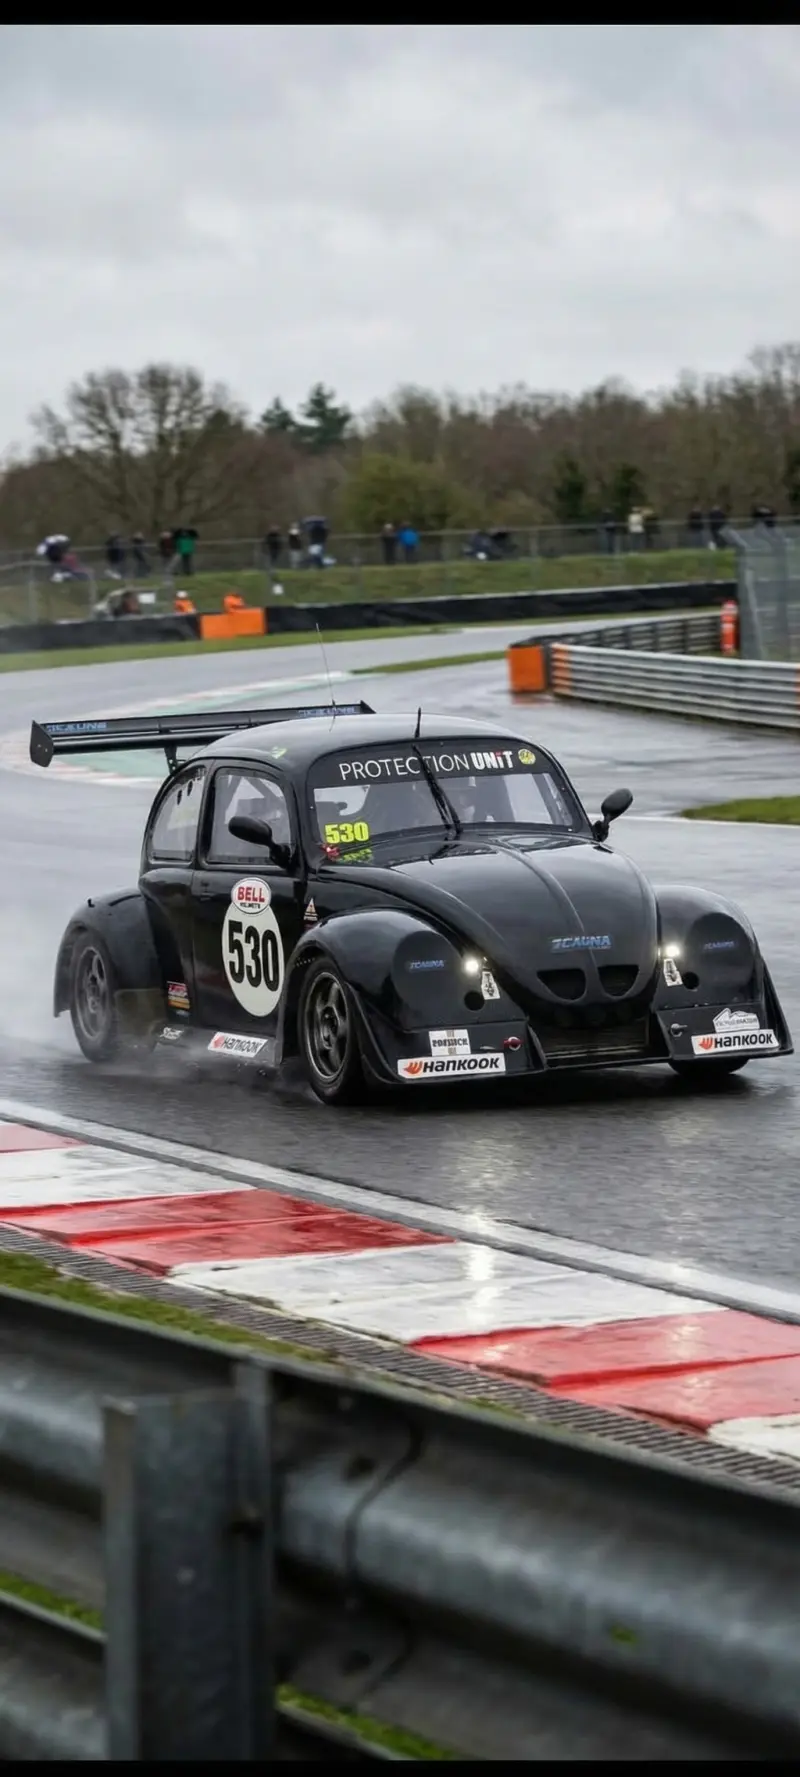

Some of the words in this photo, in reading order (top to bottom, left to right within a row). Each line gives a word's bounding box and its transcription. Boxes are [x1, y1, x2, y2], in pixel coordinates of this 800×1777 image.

[325, 822, 369, 844] 530
[237, 886, 265, 902] BELL
[229, 920, 279, 991] 530
